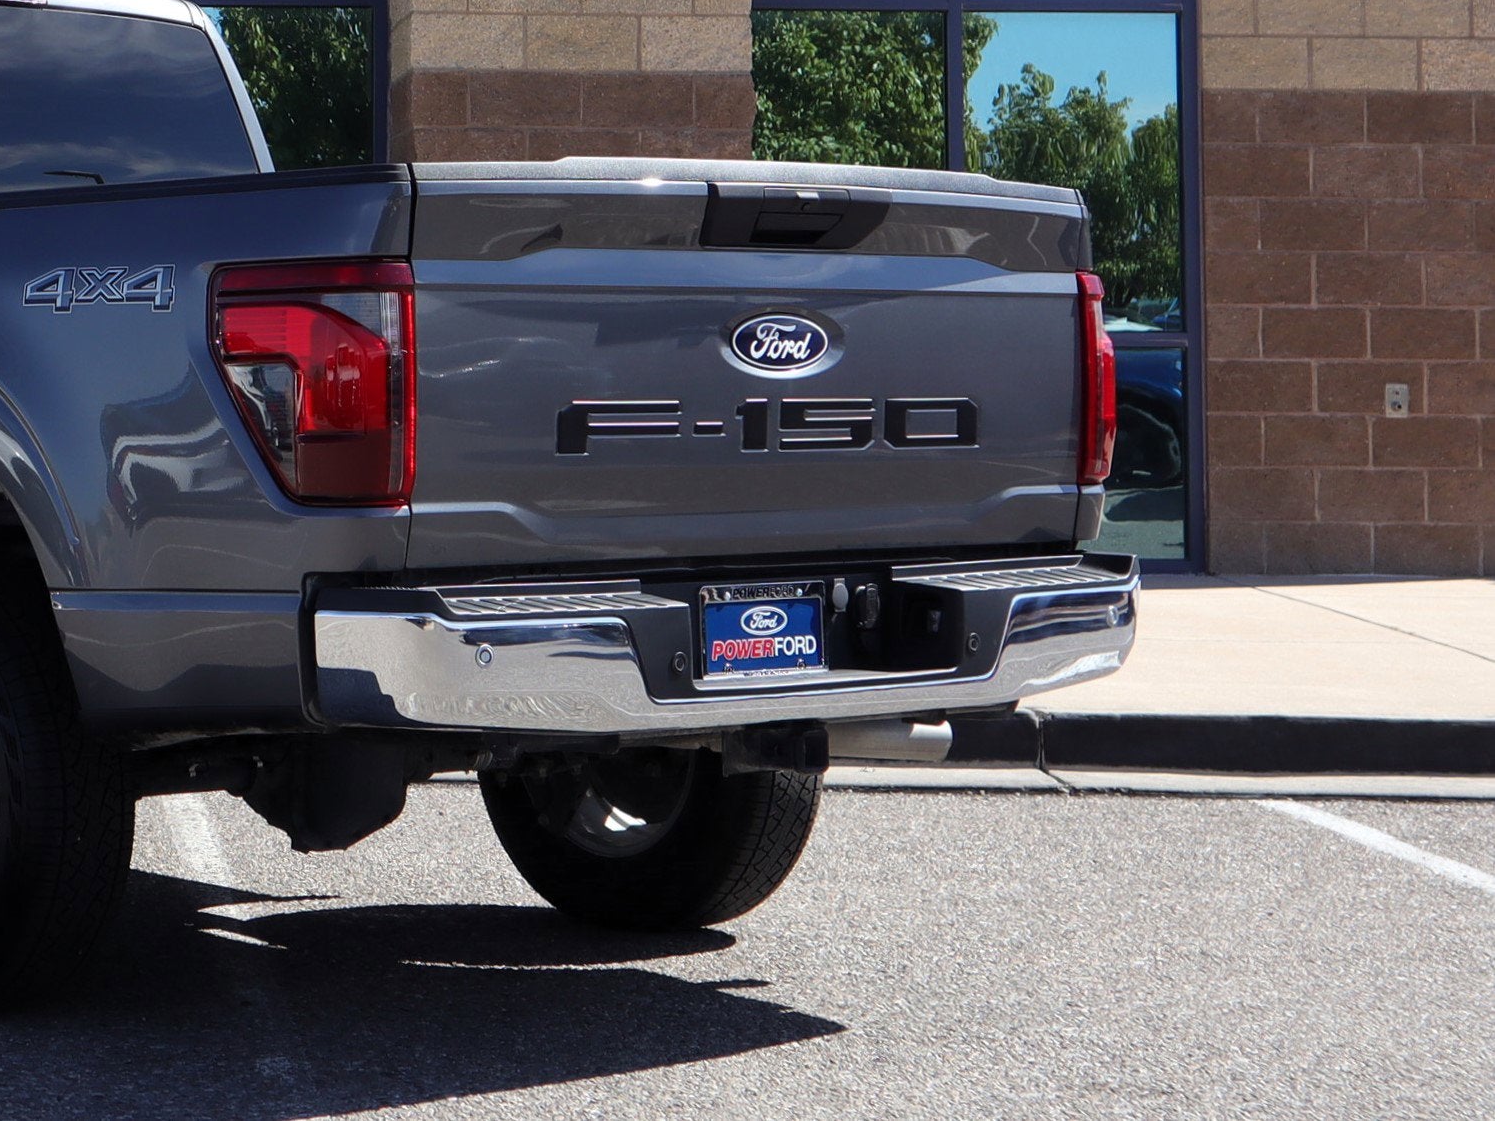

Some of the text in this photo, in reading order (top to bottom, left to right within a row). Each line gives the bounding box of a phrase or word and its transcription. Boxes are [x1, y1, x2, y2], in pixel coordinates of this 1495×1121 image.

[750, 322, 810, 360] Ford
[555, 397, 980, 456] F-150
[749, 611, 778, 629] Ford
[713, 636, 816, 660] POWERFORD
